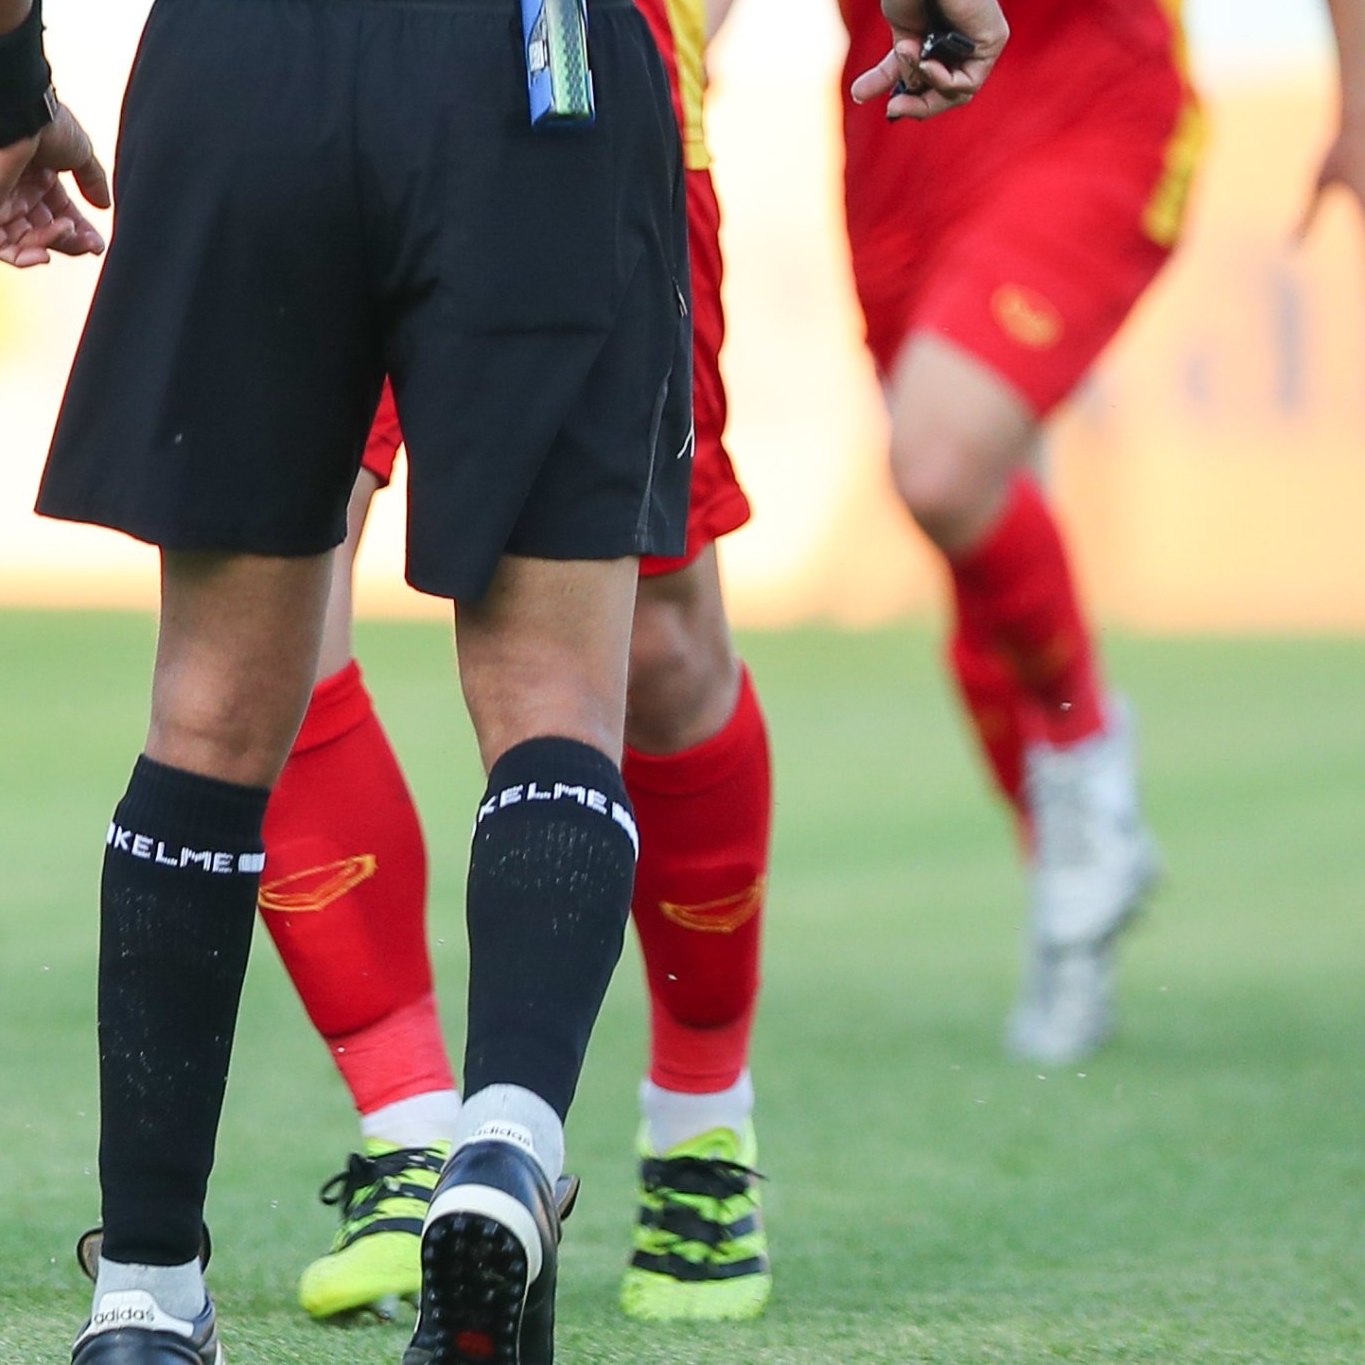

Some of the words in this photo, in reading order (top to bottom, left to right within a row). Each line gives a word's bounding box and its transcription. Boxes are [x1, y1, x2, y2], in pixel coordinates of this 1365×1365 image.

[478, 782, 607, 823] KELME
[114, 825, 234, 874] KELME
[94, 1307, 155, 1324] adidas
